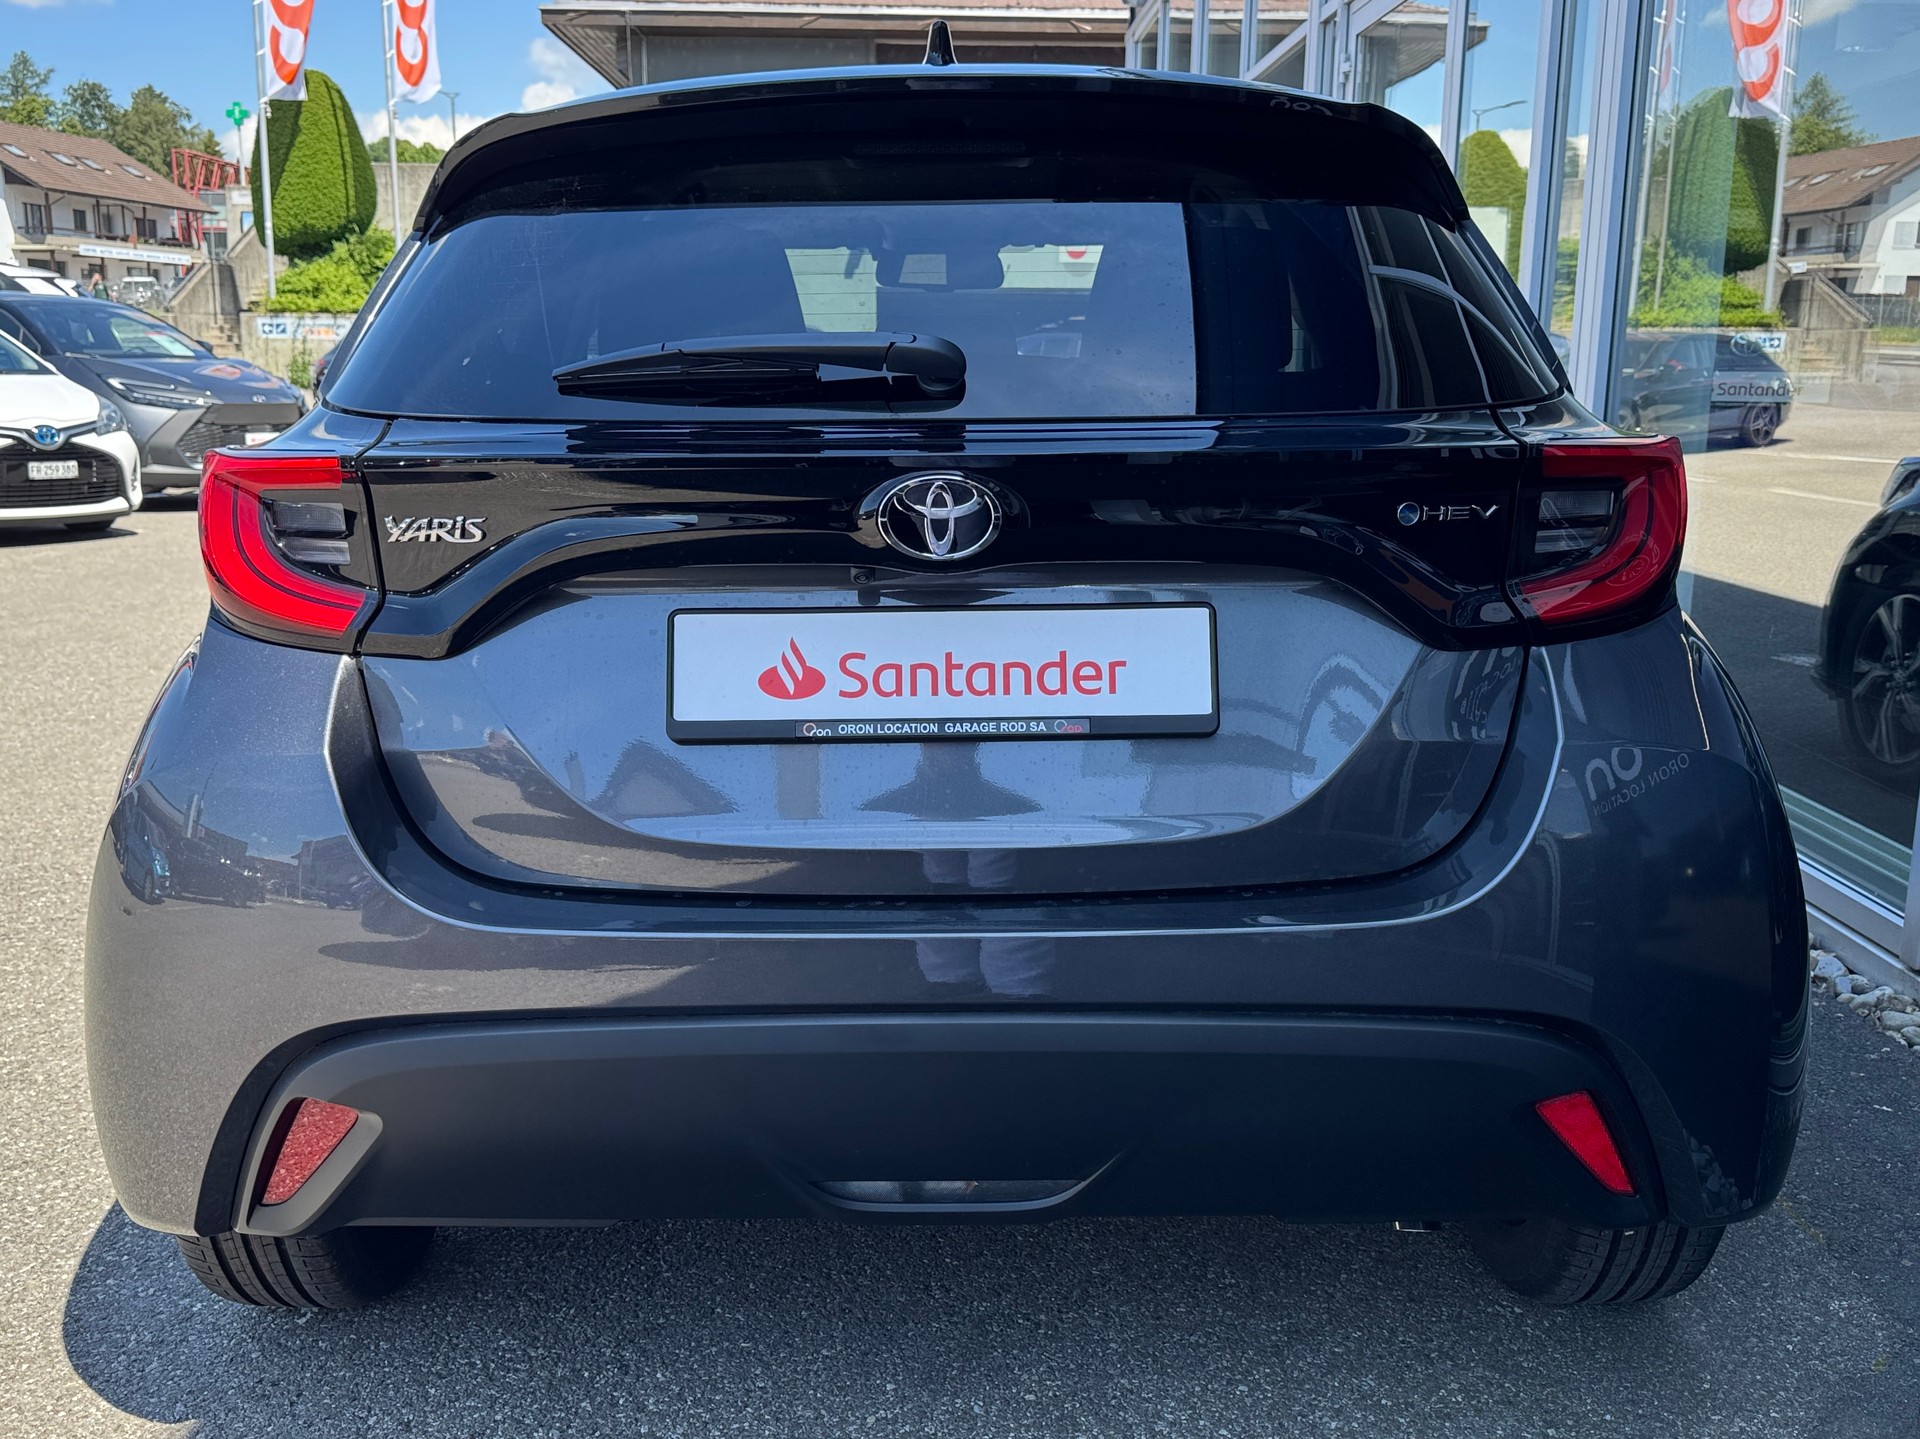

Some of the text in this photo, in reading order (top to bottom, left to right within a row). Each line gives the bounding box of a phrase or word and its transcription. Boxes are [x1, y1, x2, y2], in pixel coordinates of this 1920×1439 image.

[837, 649, 1128, 699] Santander
[838, 723, 873, 735] ORON
[877, 723, 938, 734] LOCATION
[944, 722, 997, 733] GARAGE
[1000, 722, 1027, 733] ROD
[1030, 721, 1047, 732] SA
